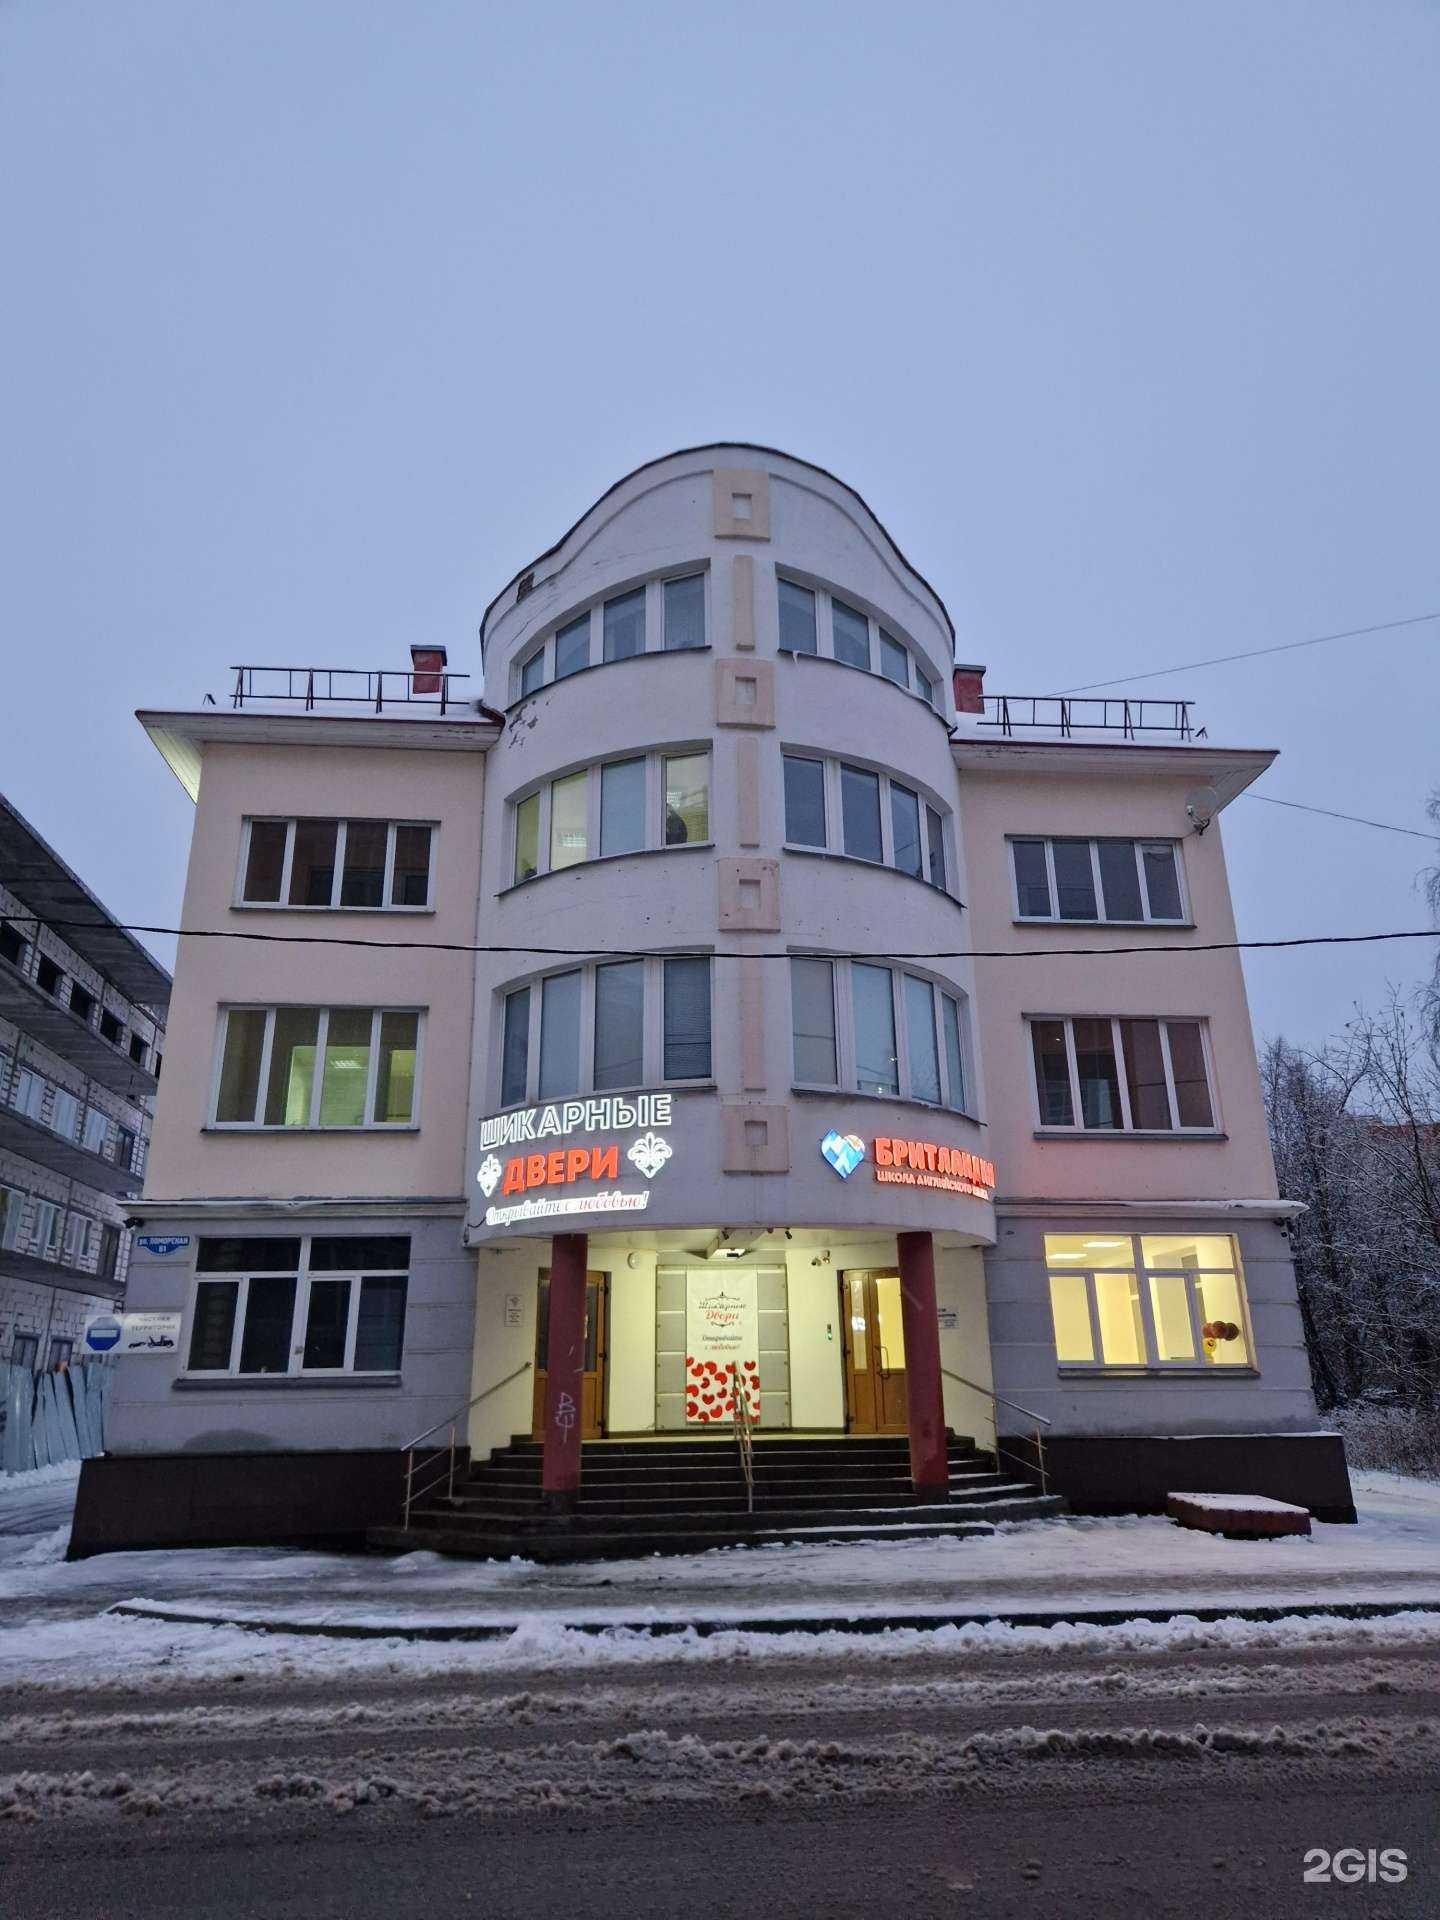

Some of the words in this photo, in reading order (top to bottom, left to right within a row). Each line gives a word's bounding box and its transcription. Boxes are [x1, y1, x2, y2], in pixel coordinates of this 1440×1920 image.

[479, 1093, 672, 1151] ШИКАРНЫЕ
[501, 1144, 619, 1196] ДВЕРИ
[876, 1170, 916, 1185] ШКОЛА
